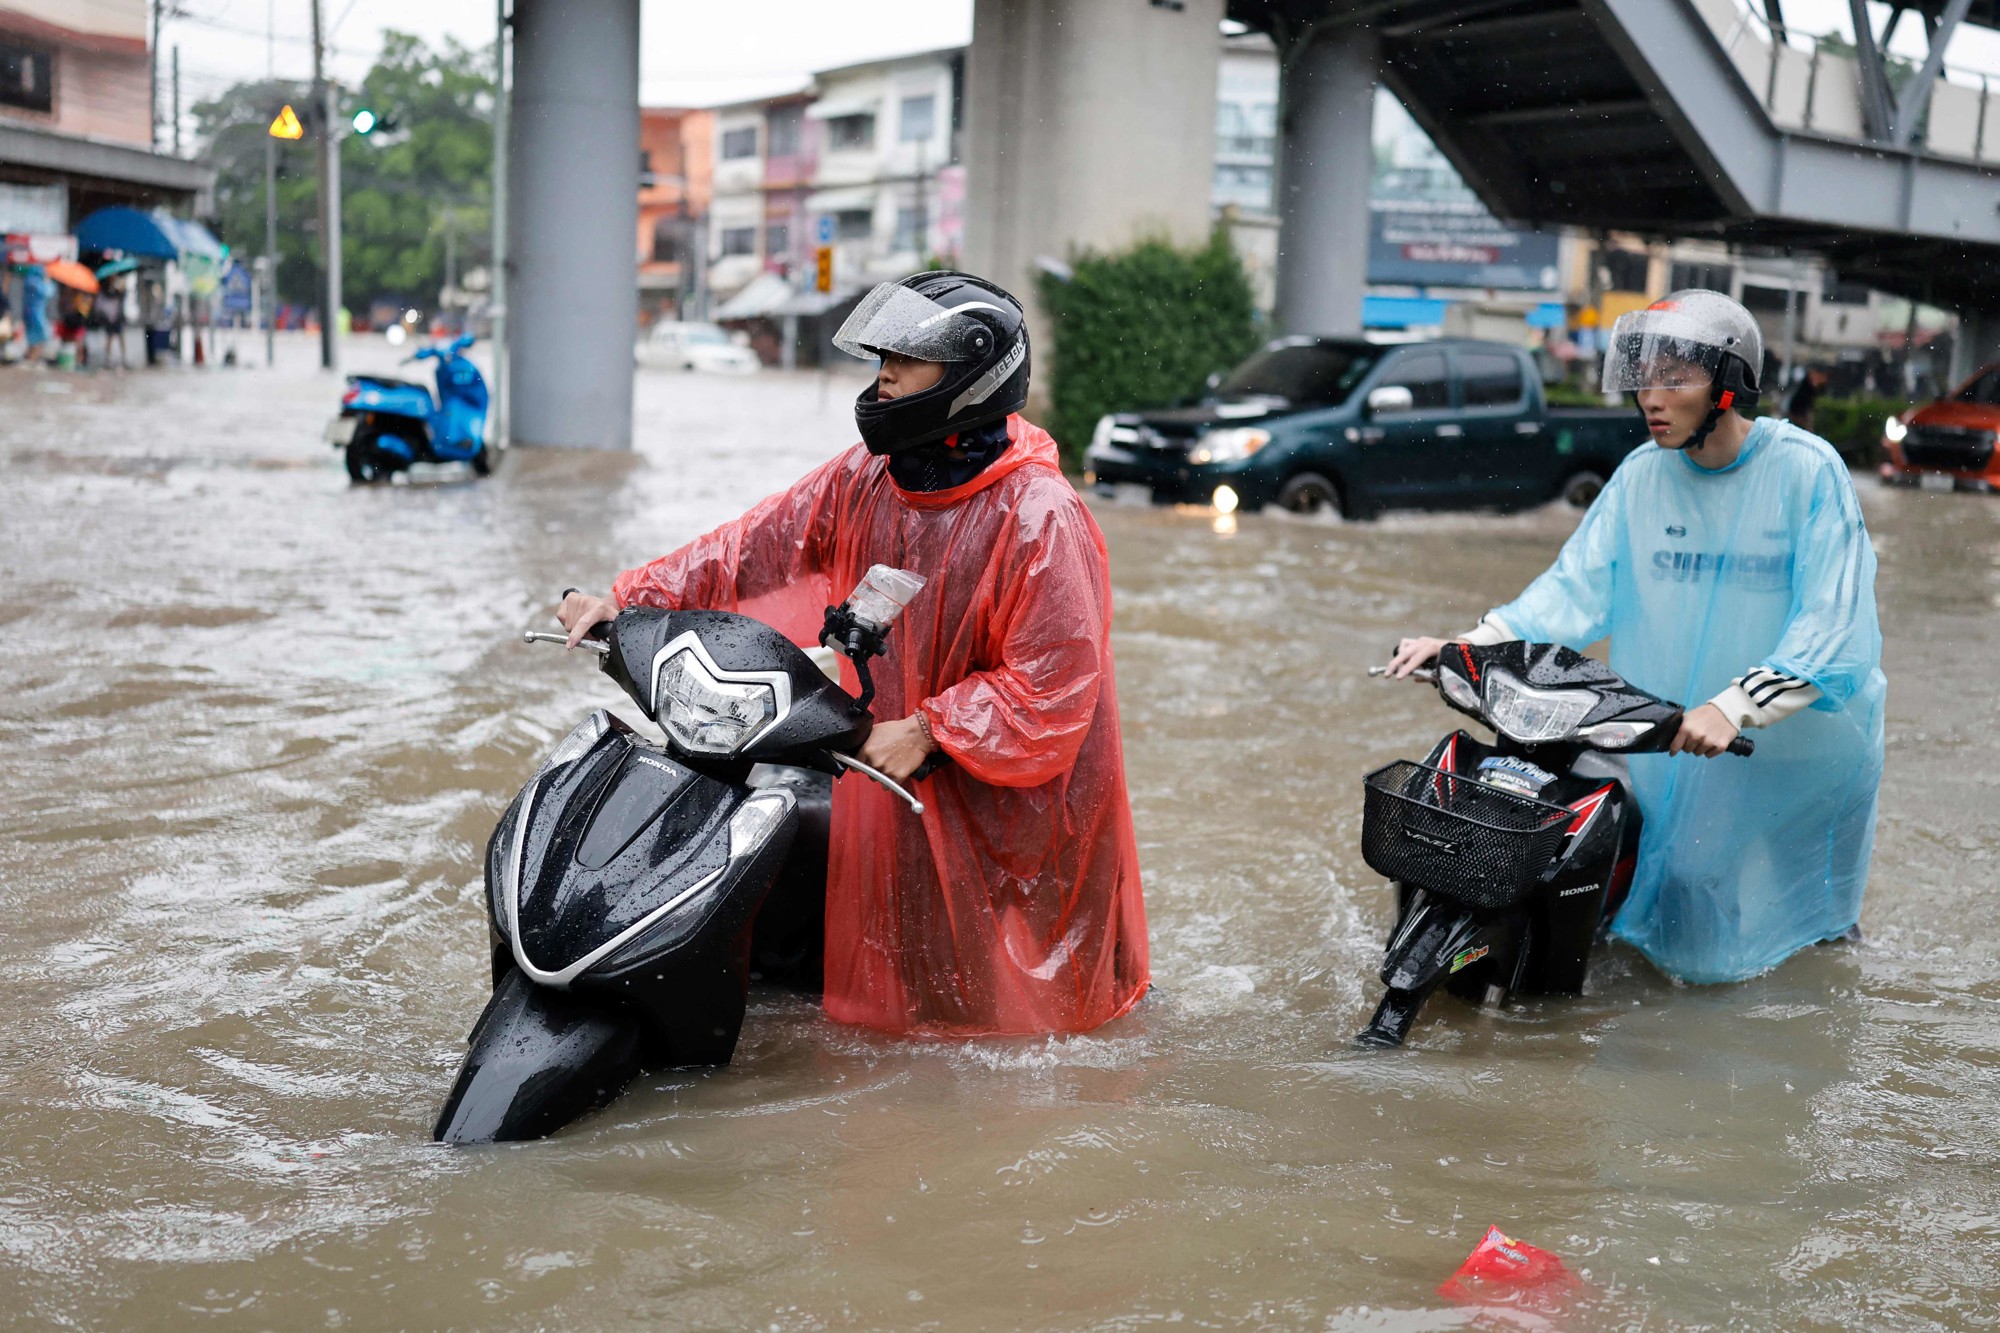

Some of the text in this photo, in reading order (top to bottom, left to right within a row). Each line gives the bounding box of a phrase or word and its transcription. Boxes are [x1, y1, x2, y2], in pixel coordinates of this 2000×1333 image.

[637, 755, 677, 777] HONDA
[1490, 770, 1532, 789] HONDA
[1560, 883, 1600, 897] HONDA
